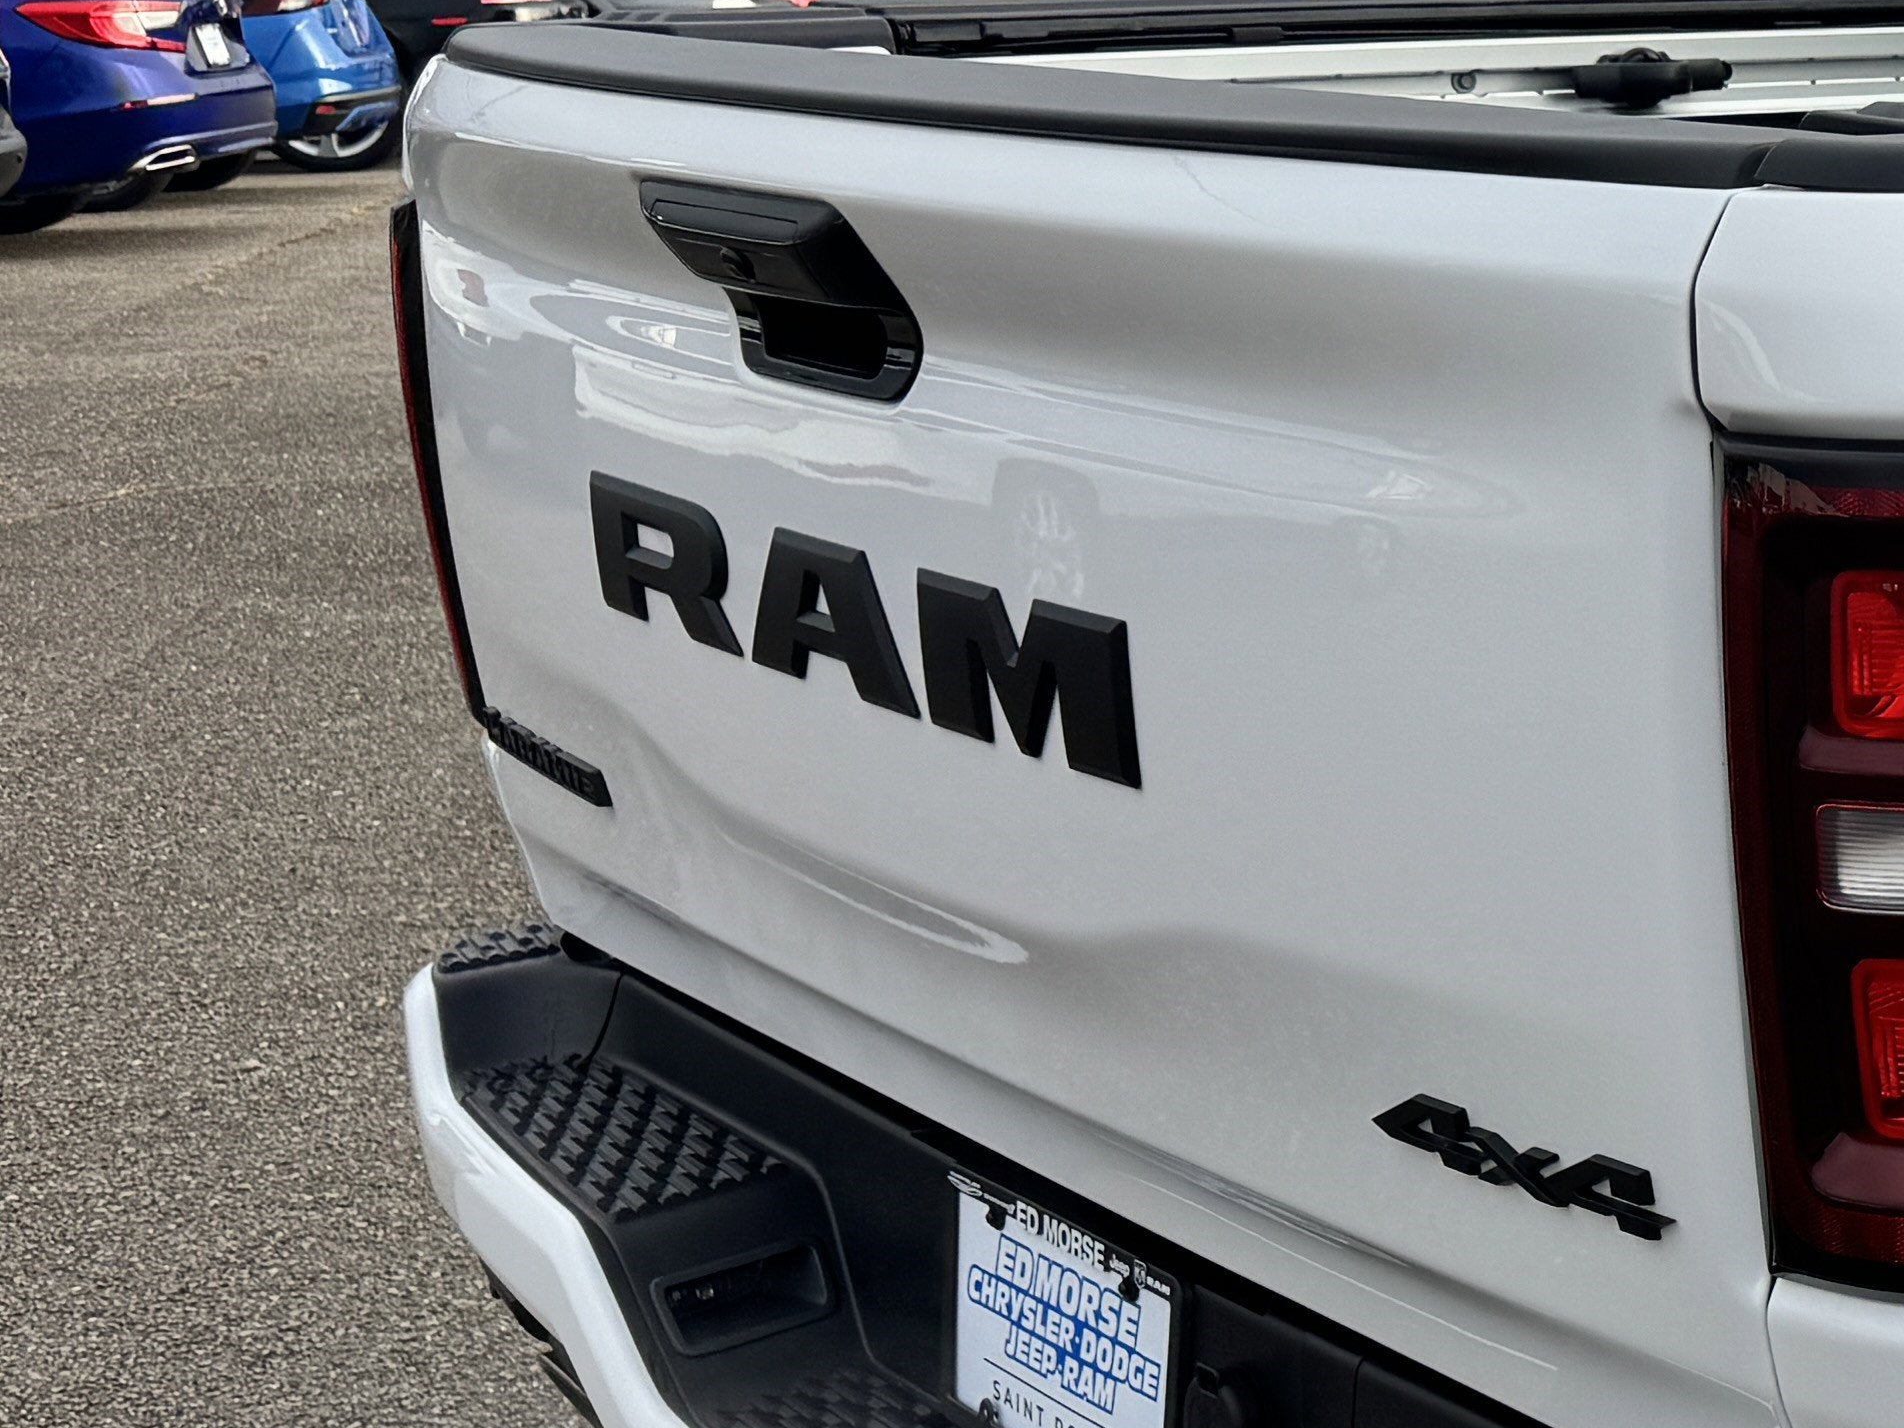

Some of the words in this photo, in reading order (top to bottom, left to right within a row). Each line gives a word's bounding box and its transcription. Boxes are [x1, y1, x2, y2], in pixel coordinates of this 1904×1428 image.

[589, 469, 1143, 790] RAM
[1016, 1199, 1040, 1236] ED
[1042, 1214, 1106, 1272] MORSE
[968, 1264, 1075, 1354] CHRYSLER
[1079, 1328, 1161, 1402] DODGE
[997, 1234, 1034, 1291] ED
[1033, 1253, 1142, 1348] MORSE
[993, 1379, 1045, 1427] SAINT
[1005, 1322, 1058, 1378] JEEP
[1061, 1356, 1118, 1415] RAM
